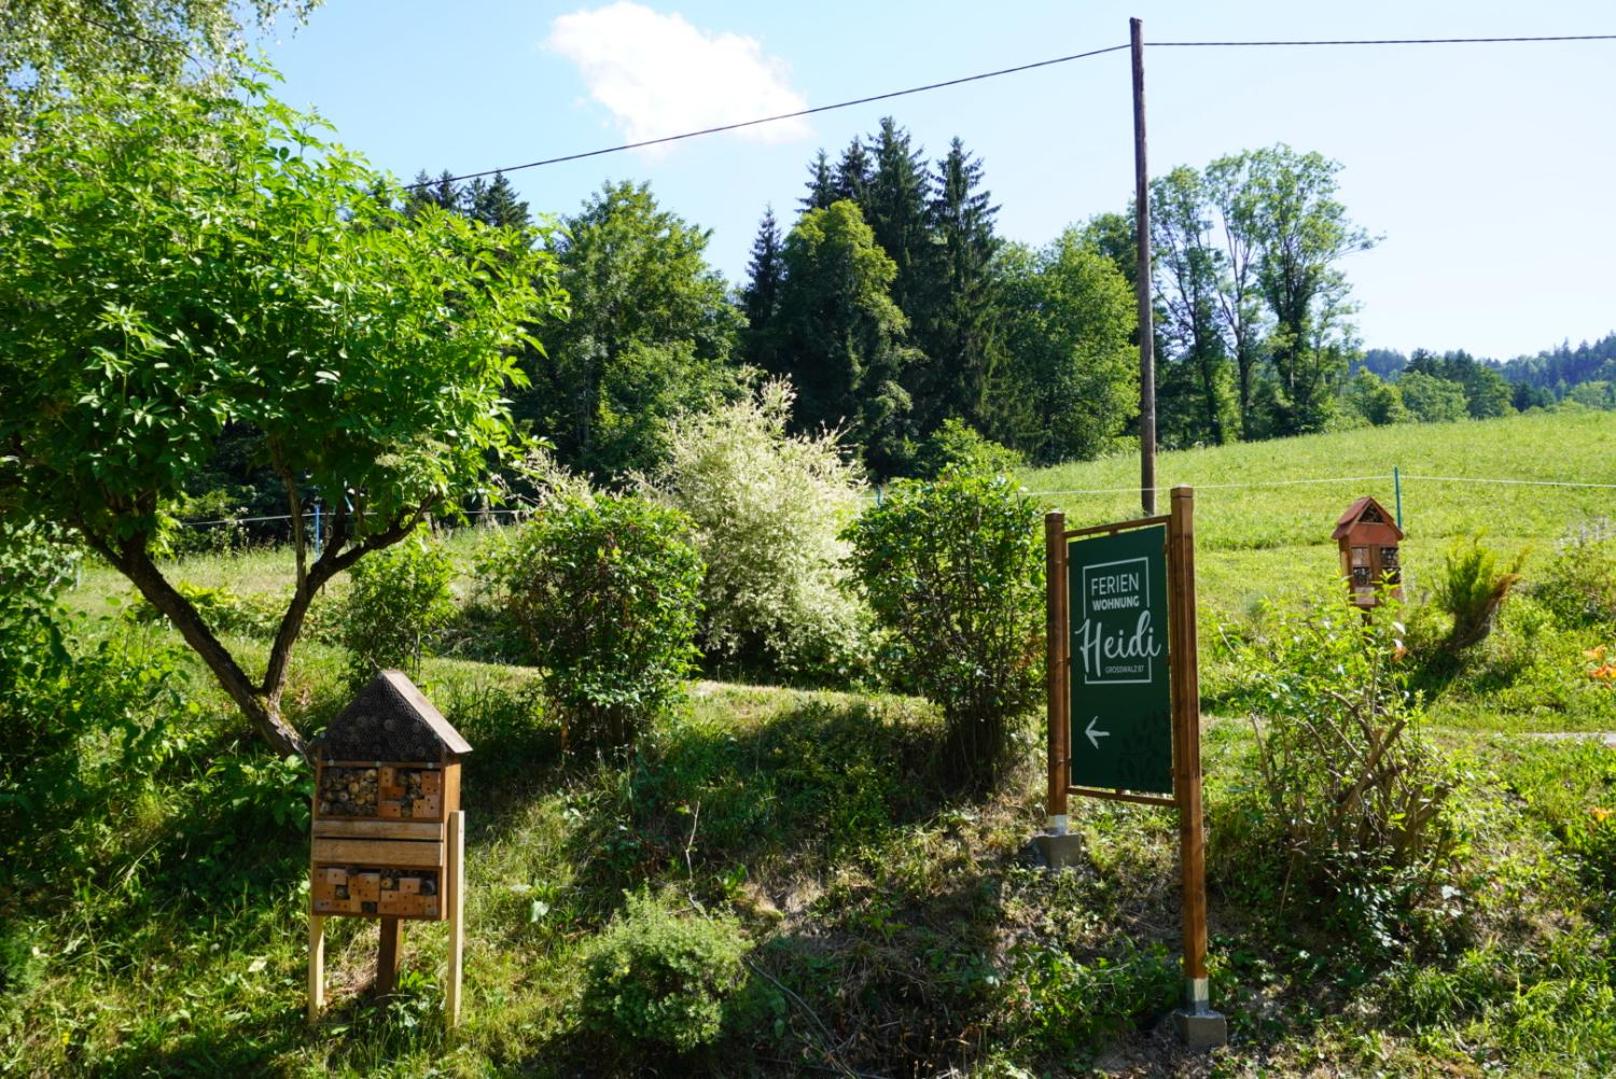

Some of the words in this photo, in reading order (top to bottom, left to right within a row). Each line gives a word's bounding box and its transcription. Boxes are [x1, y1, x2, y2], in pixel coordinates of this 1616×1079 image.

[1091, 572, 1140, 596] FERIEN
[1092, 595, 1140, 611] WOHNUNG
[1074, 610, 1162, 678] Heidi
